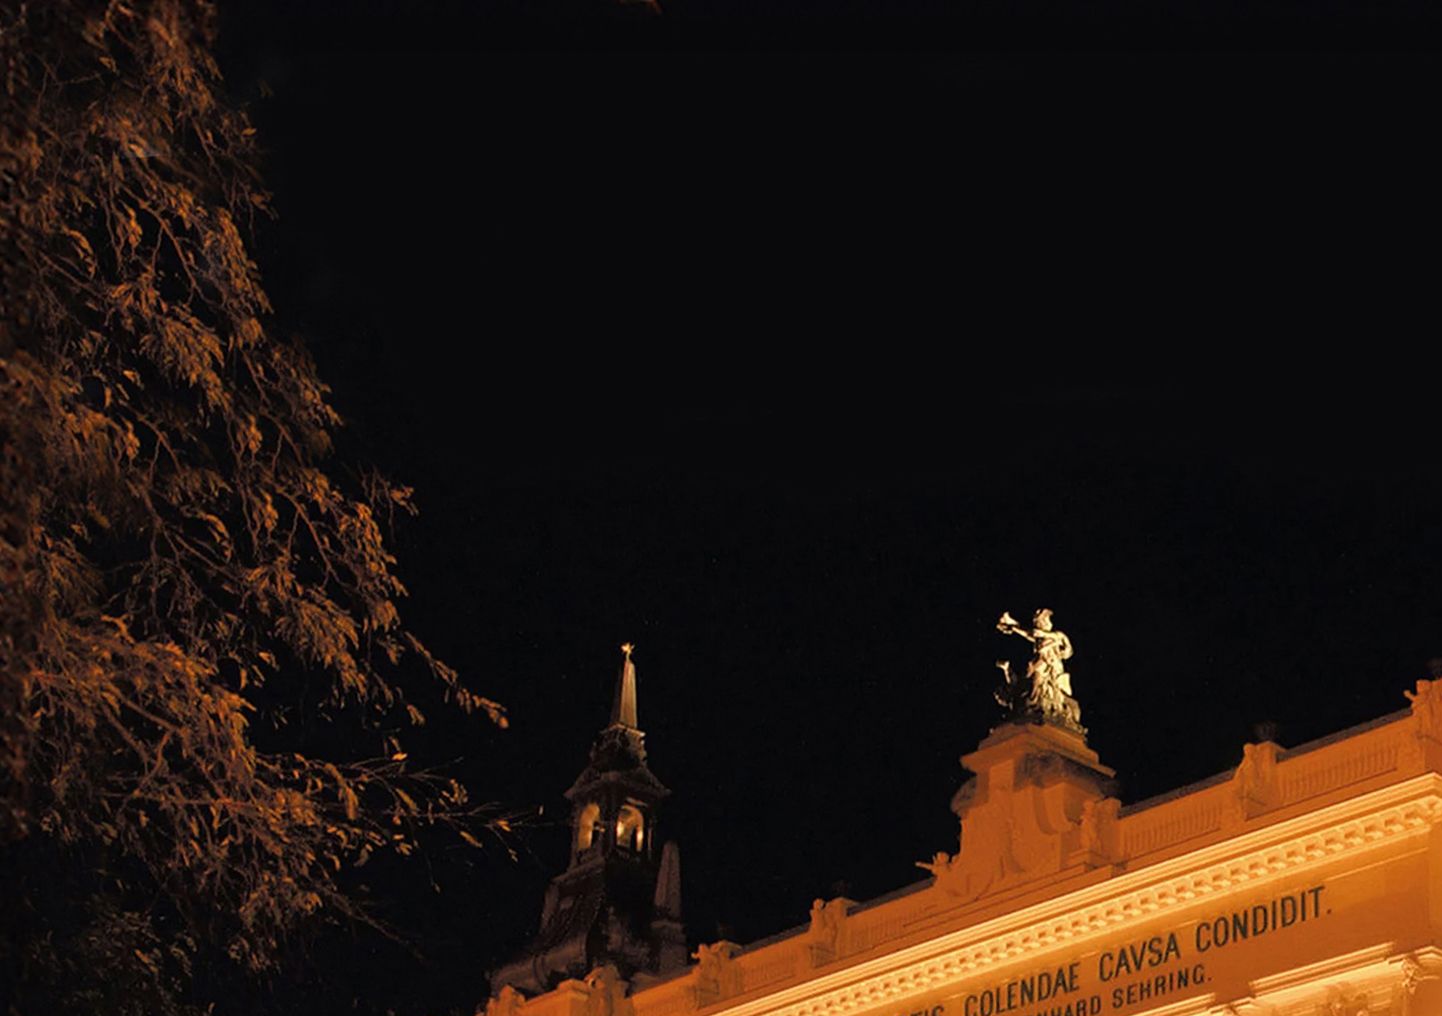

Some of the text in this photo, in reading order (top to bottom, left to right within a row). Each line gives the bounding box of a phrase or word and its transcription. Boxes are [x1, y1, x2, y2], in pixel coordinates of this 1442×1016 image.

[1099, 932, 1181, 983] CAVSA
[1196, 886, 1332, 953] CONDIDIT.
[1112, 964, 1212, 1010] SEHRING.
